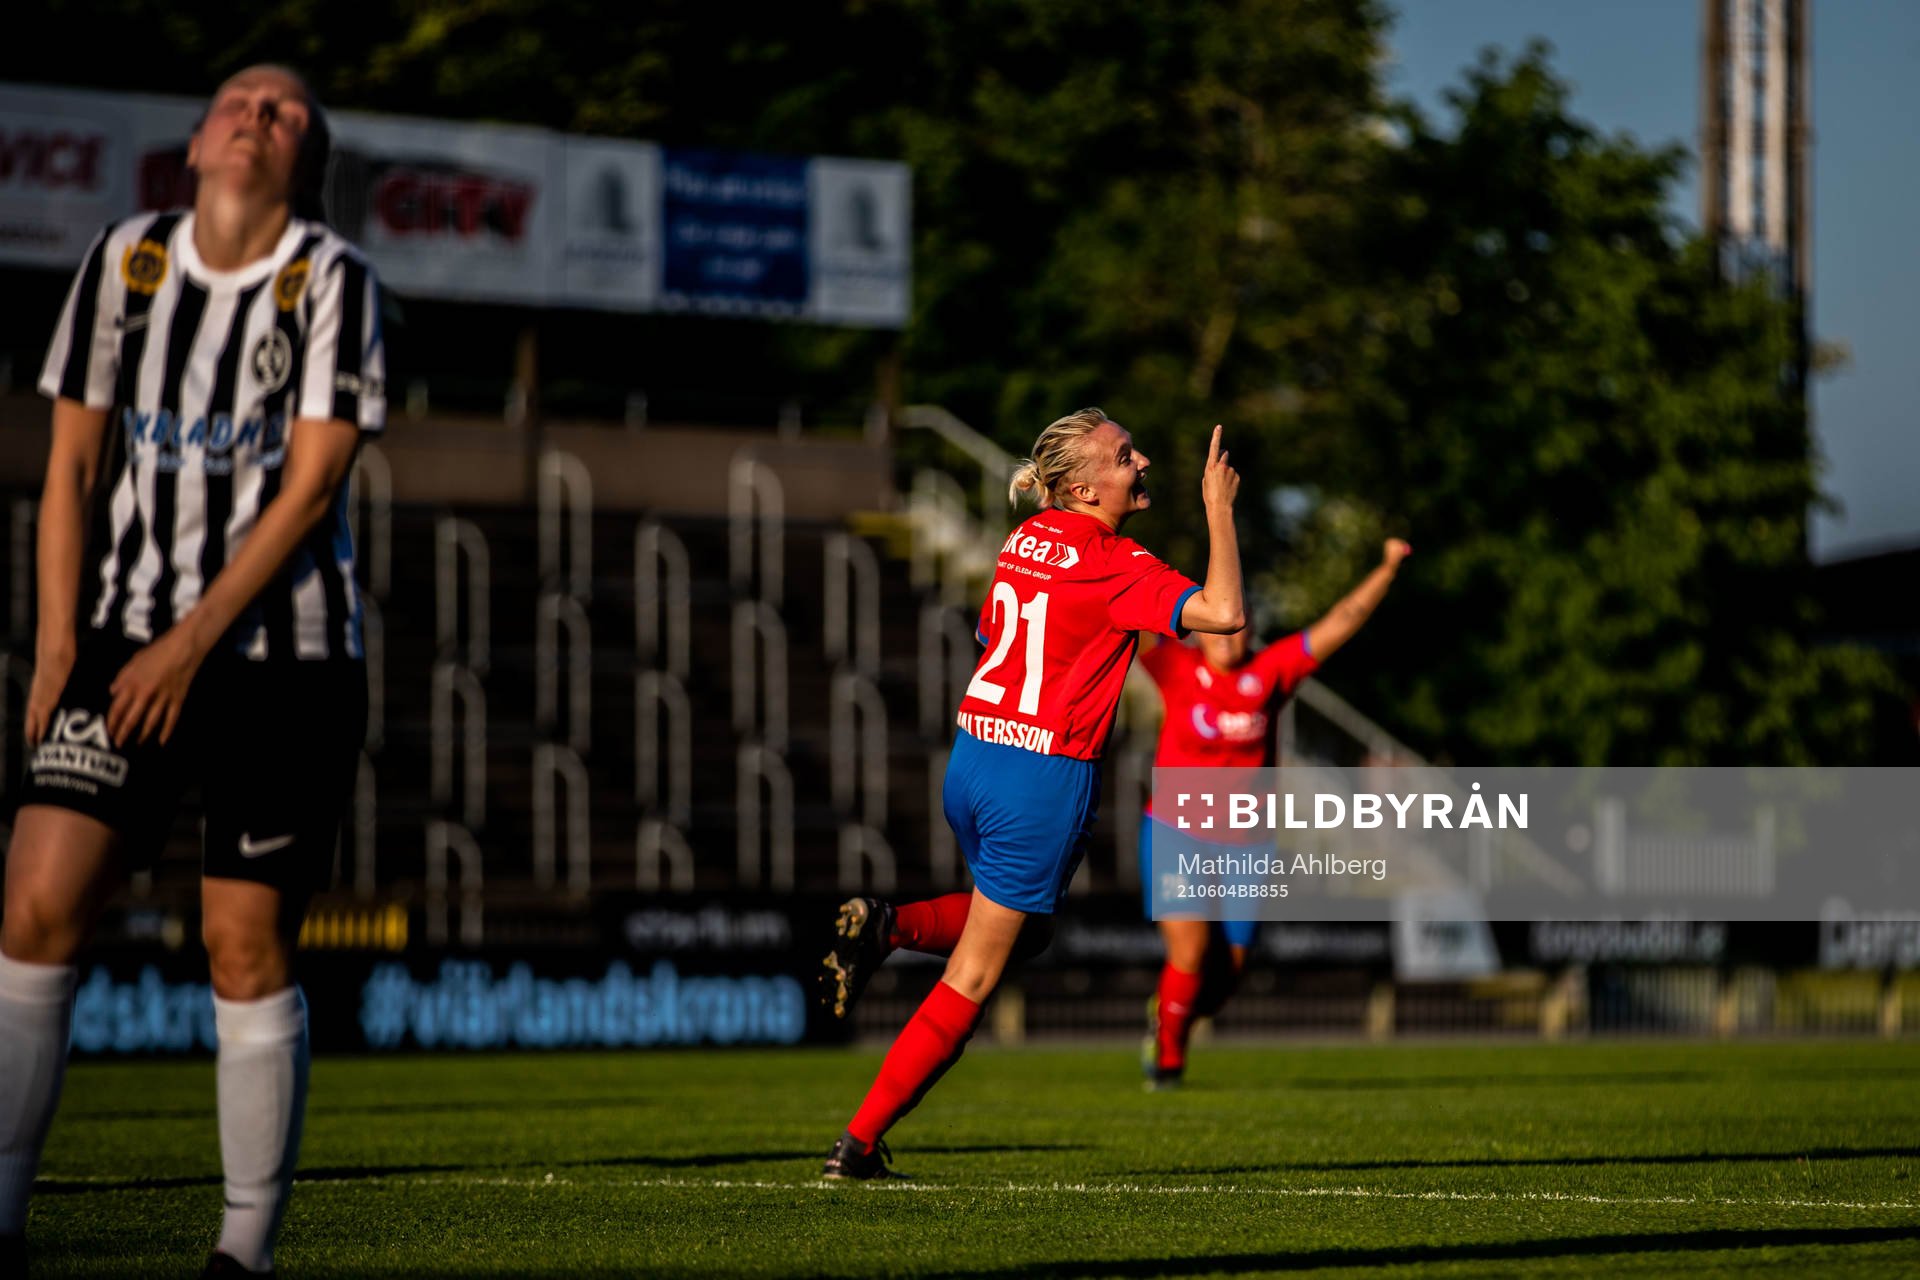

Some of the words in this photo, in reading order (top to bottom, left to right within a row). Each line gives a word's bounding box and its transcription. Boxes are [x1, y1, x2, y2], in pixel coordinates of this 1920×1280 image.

[1007, 562, 1015, 570] OF
[1015, 566, 1032, 576] ELEDA
[1032, 571, 1052, 581] GROUP
[966, 581, 1049, 716] 21
[50, 707, 110, 750] ICA
